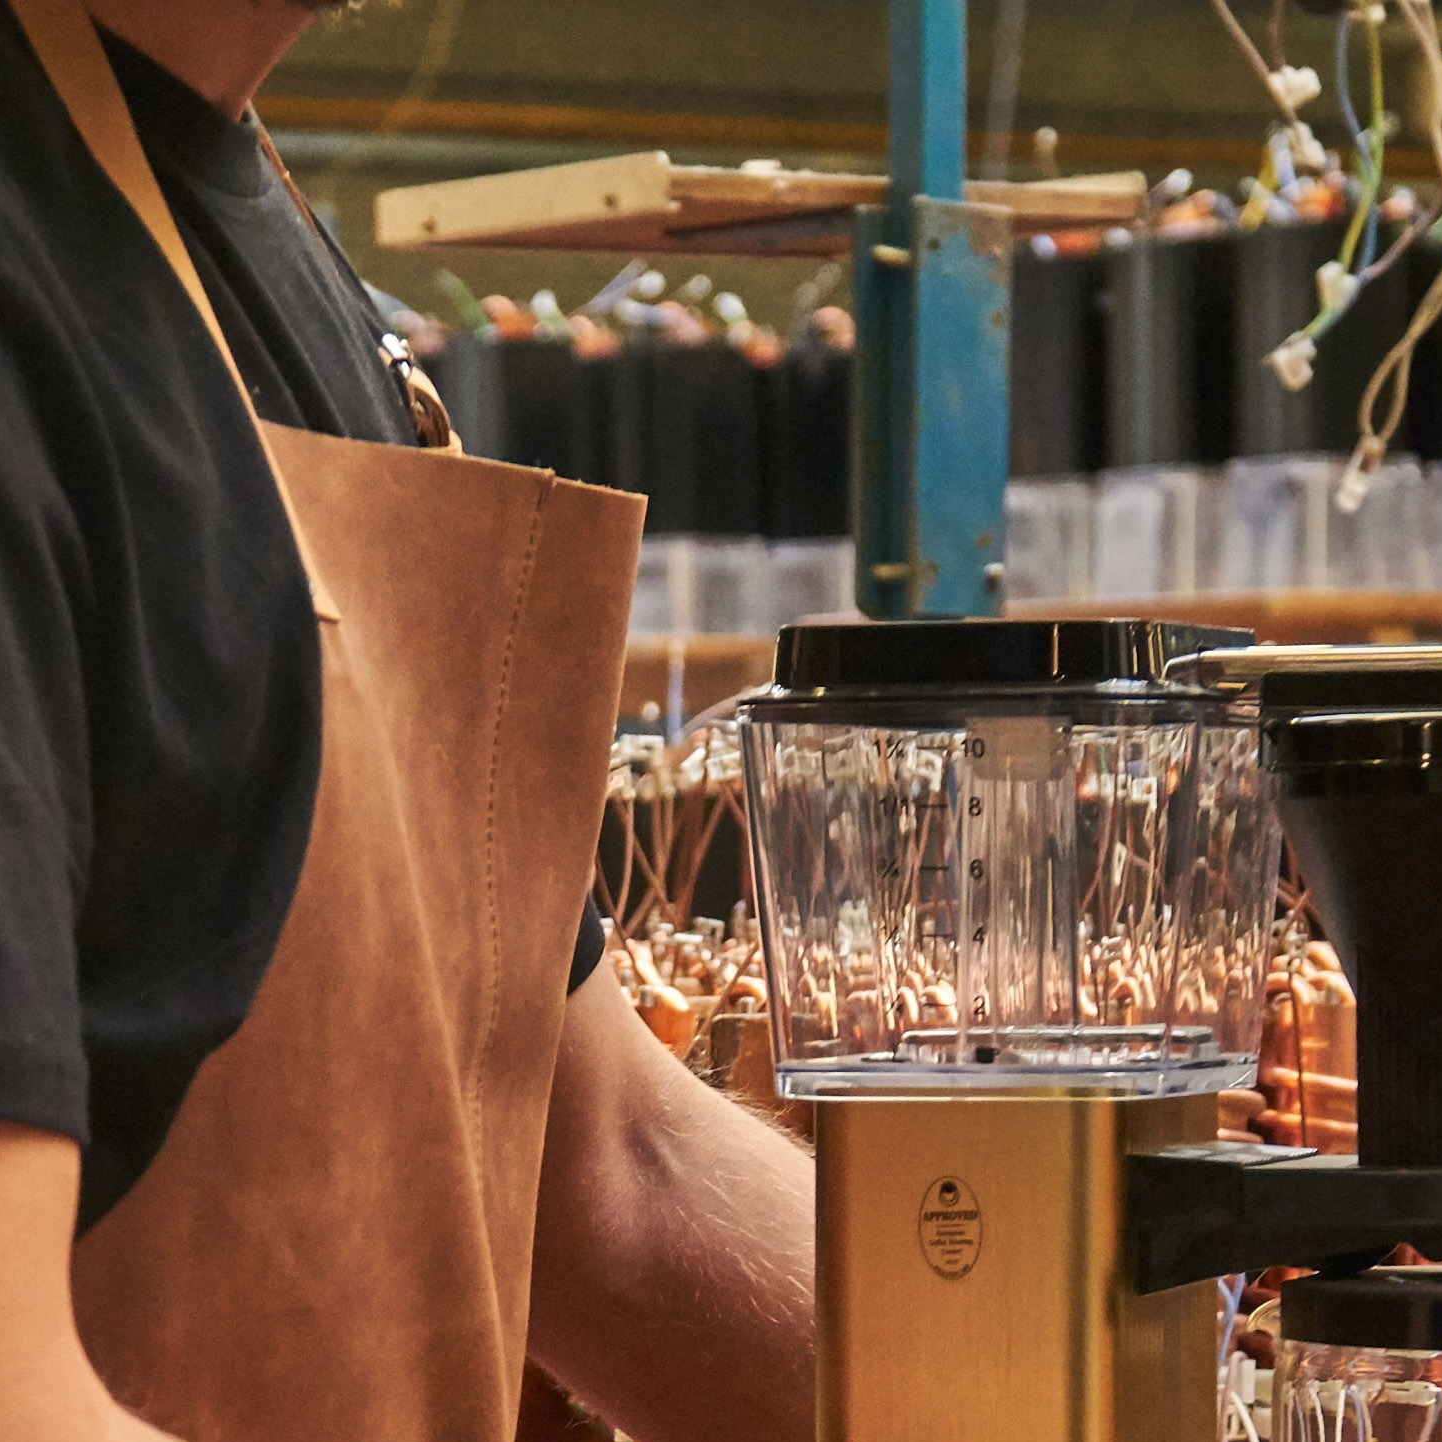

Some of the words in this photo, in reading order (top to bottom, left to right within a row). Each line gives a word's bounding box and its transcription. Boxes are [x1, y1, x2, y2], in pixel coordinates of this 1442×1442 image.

[961, 738, 986, 759] 10
[968, 796, 982, 817] 8
[969, 859, 984, 880] 6
[972, 926, 985, 945] 4
[973, 996, 986, 1016] 2
